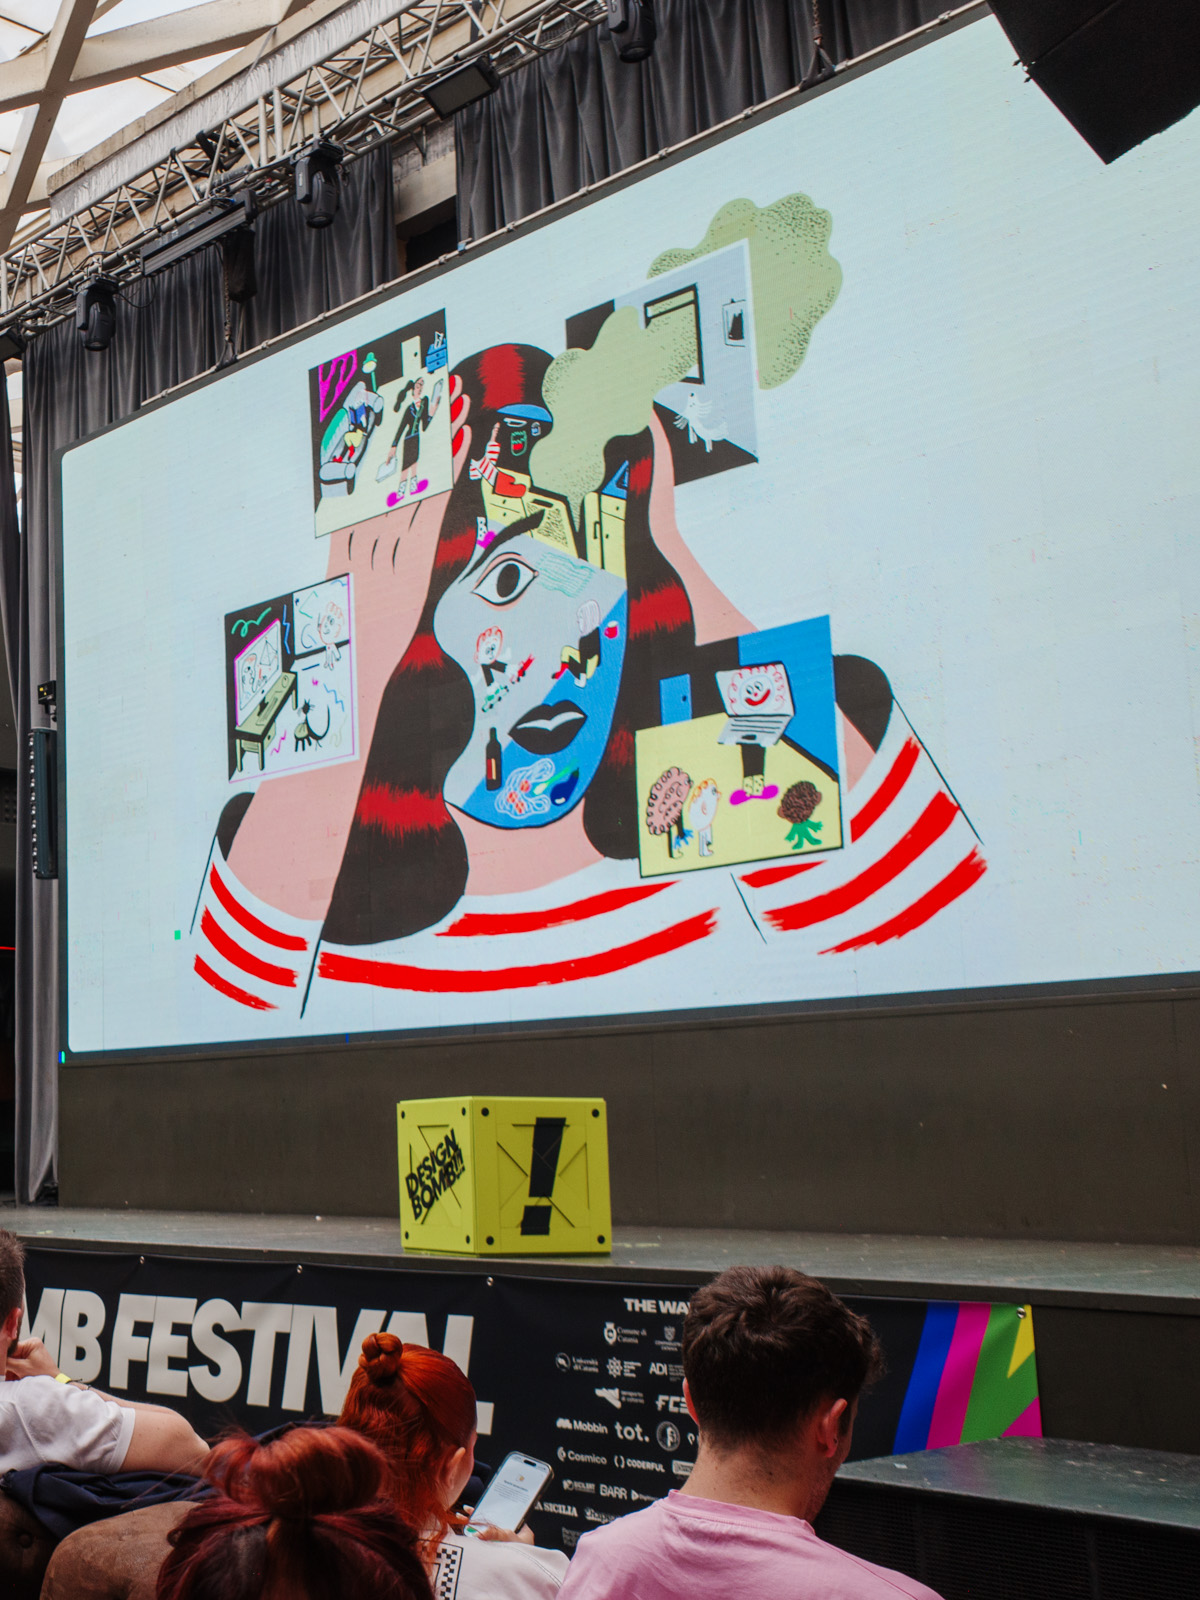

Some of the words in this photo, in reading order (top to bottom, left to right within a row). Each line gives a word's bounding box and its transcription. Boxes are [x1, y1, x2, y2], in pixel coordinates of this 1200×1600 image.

[406, 1127, 459, 1199] DESIGN
[623, 1297, 657, 1313] THE
[658, 1300, 691, 1315] WA
[109, 1292, 495, 1435] FESTIVL
[649, 1362, 668, 1376] ADI
[573, 1419, 608, 1434] Mobbin
[614, 1421, 650, 1442] tot.
[567, 1450, 607, 1465] Cosmico
[626, 1458, 665, 1473] CODERFUL
[600, 1483, 628, 1500] BARR
[544, 1501, 578, 1517] SICILIA
